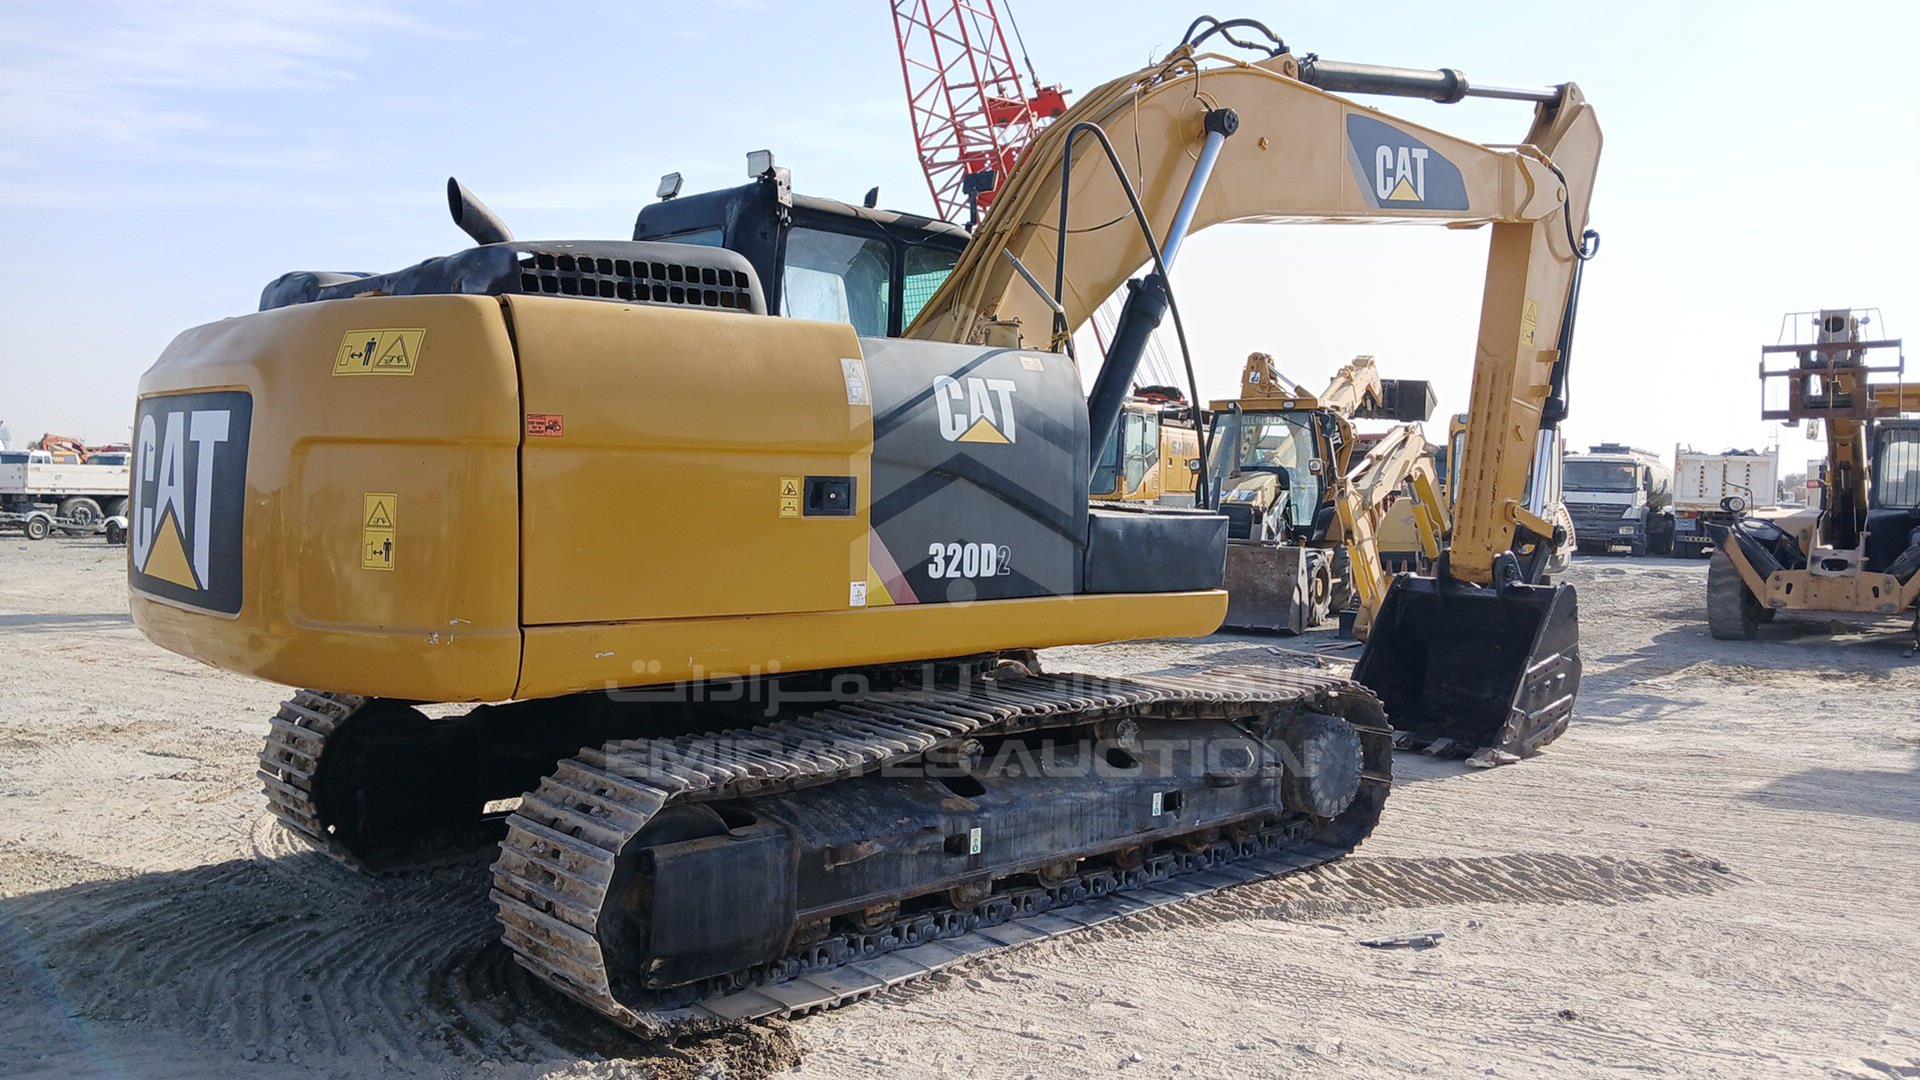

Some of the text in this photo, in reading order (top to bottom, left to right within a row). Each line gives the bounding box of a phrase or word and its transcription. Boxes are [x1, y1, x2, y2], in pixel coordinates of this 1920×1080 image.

[1375, 145, 1429, 201] CAT
[933, 375, 1017, 444] CAT
[133, 410, 231, 591] CAT
[928, 542, 1012, 579] 320D2
